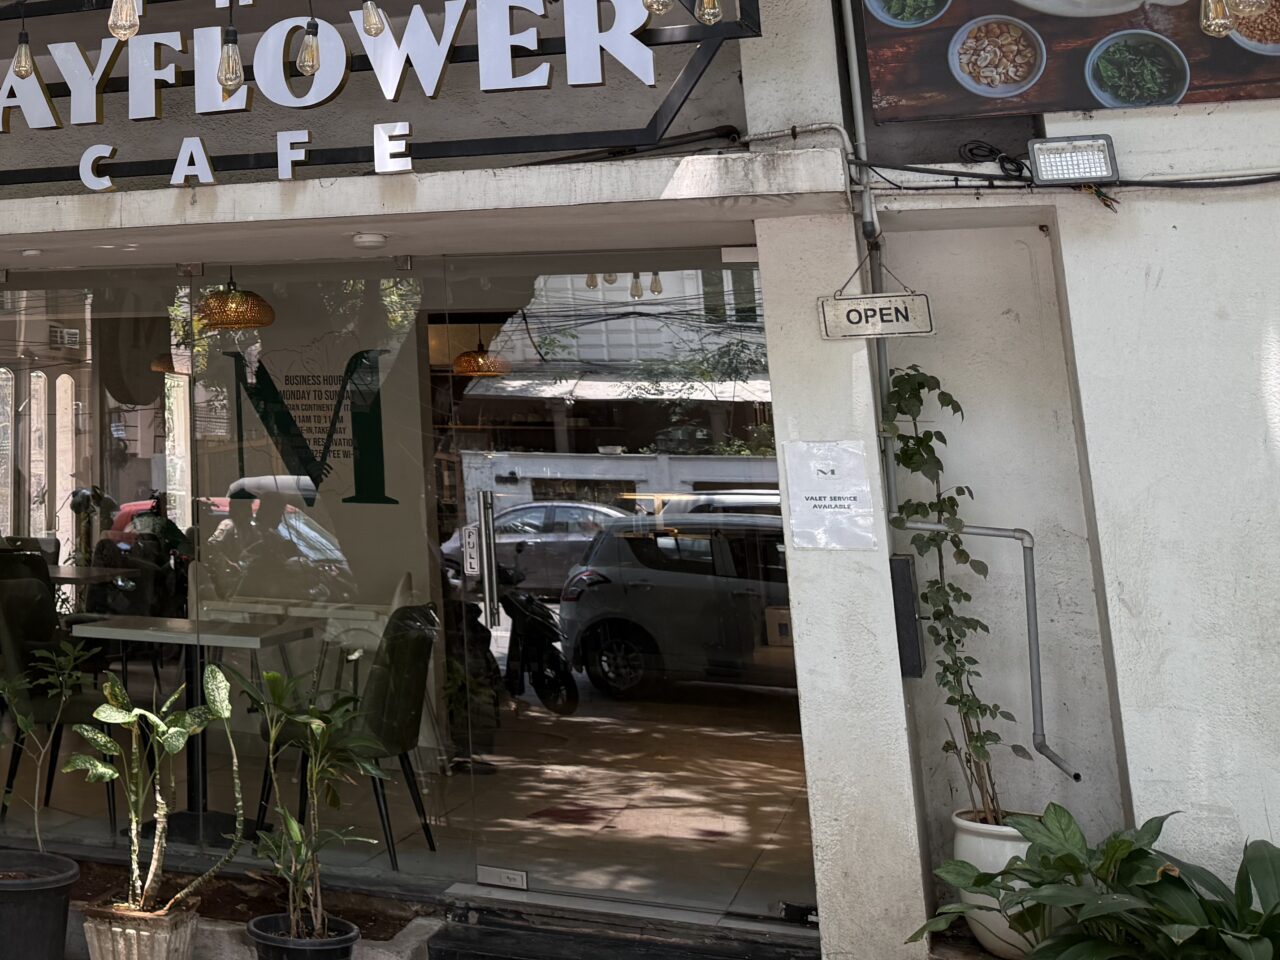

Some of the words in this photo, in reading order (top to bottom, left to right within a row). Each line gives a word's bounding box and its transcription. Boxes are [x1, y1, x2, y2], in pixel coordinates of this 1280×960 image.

[78, 121, 414, 191] CAFE
[845, 305, 910, 325] OPEN
[284, 375, 321, 386] BUSINESS
[323, 375, 347, 386] HOUR
[313, 389, 323, 401] TO
[324, 389, 352, 401] SUNA
[467, 530, 476, 570] PULL
